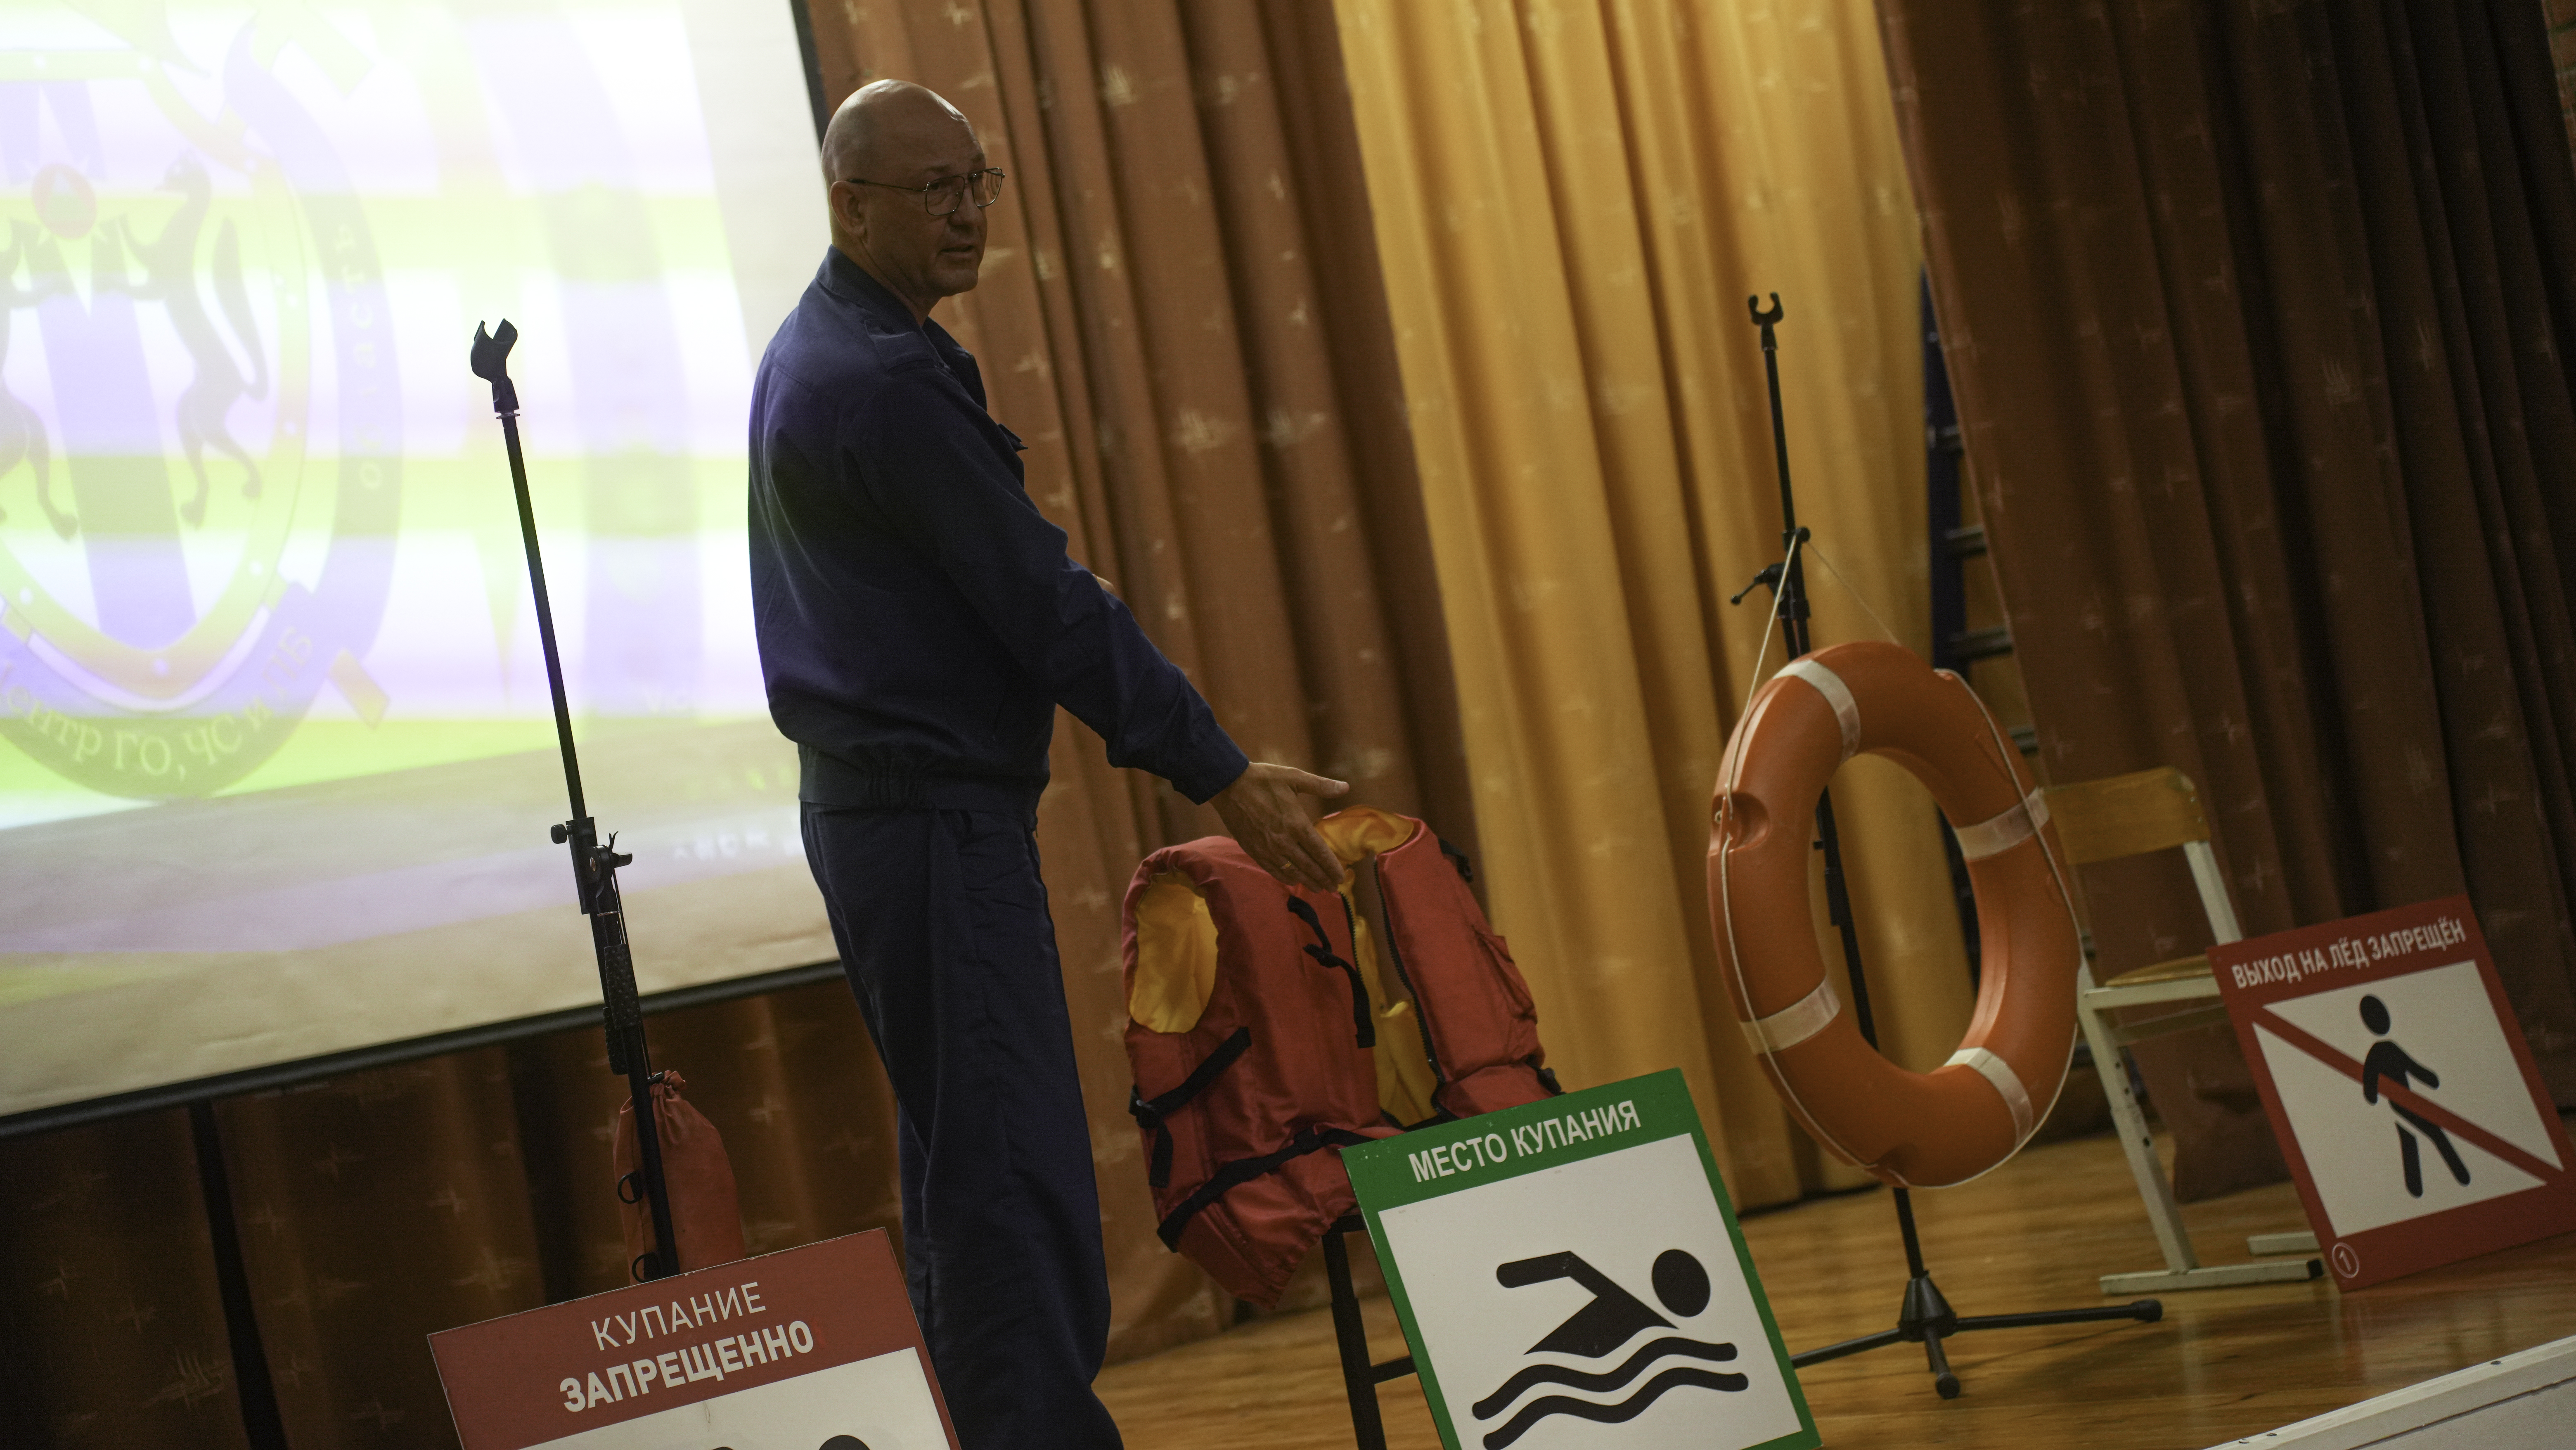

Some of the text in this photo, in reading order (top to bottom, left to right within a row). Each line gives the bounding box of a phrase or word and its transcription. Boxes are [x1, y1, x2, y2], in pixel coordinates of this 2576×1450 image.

[1, 685, 103, 763] ентр
[183, 713, 243, 766] ЧС
[2231, 916, 2466, 989] ВЫХОД НА ЛЁД ЗАПРЕЩЁН
[1408, 1099, 1641, 1183] МЕСТО КУПАНИЯ
[591, 1281, 767, 1351] КУПАНИЕ
[559, 1320, 814, 1412] ЗАПРЕЩЕННО
